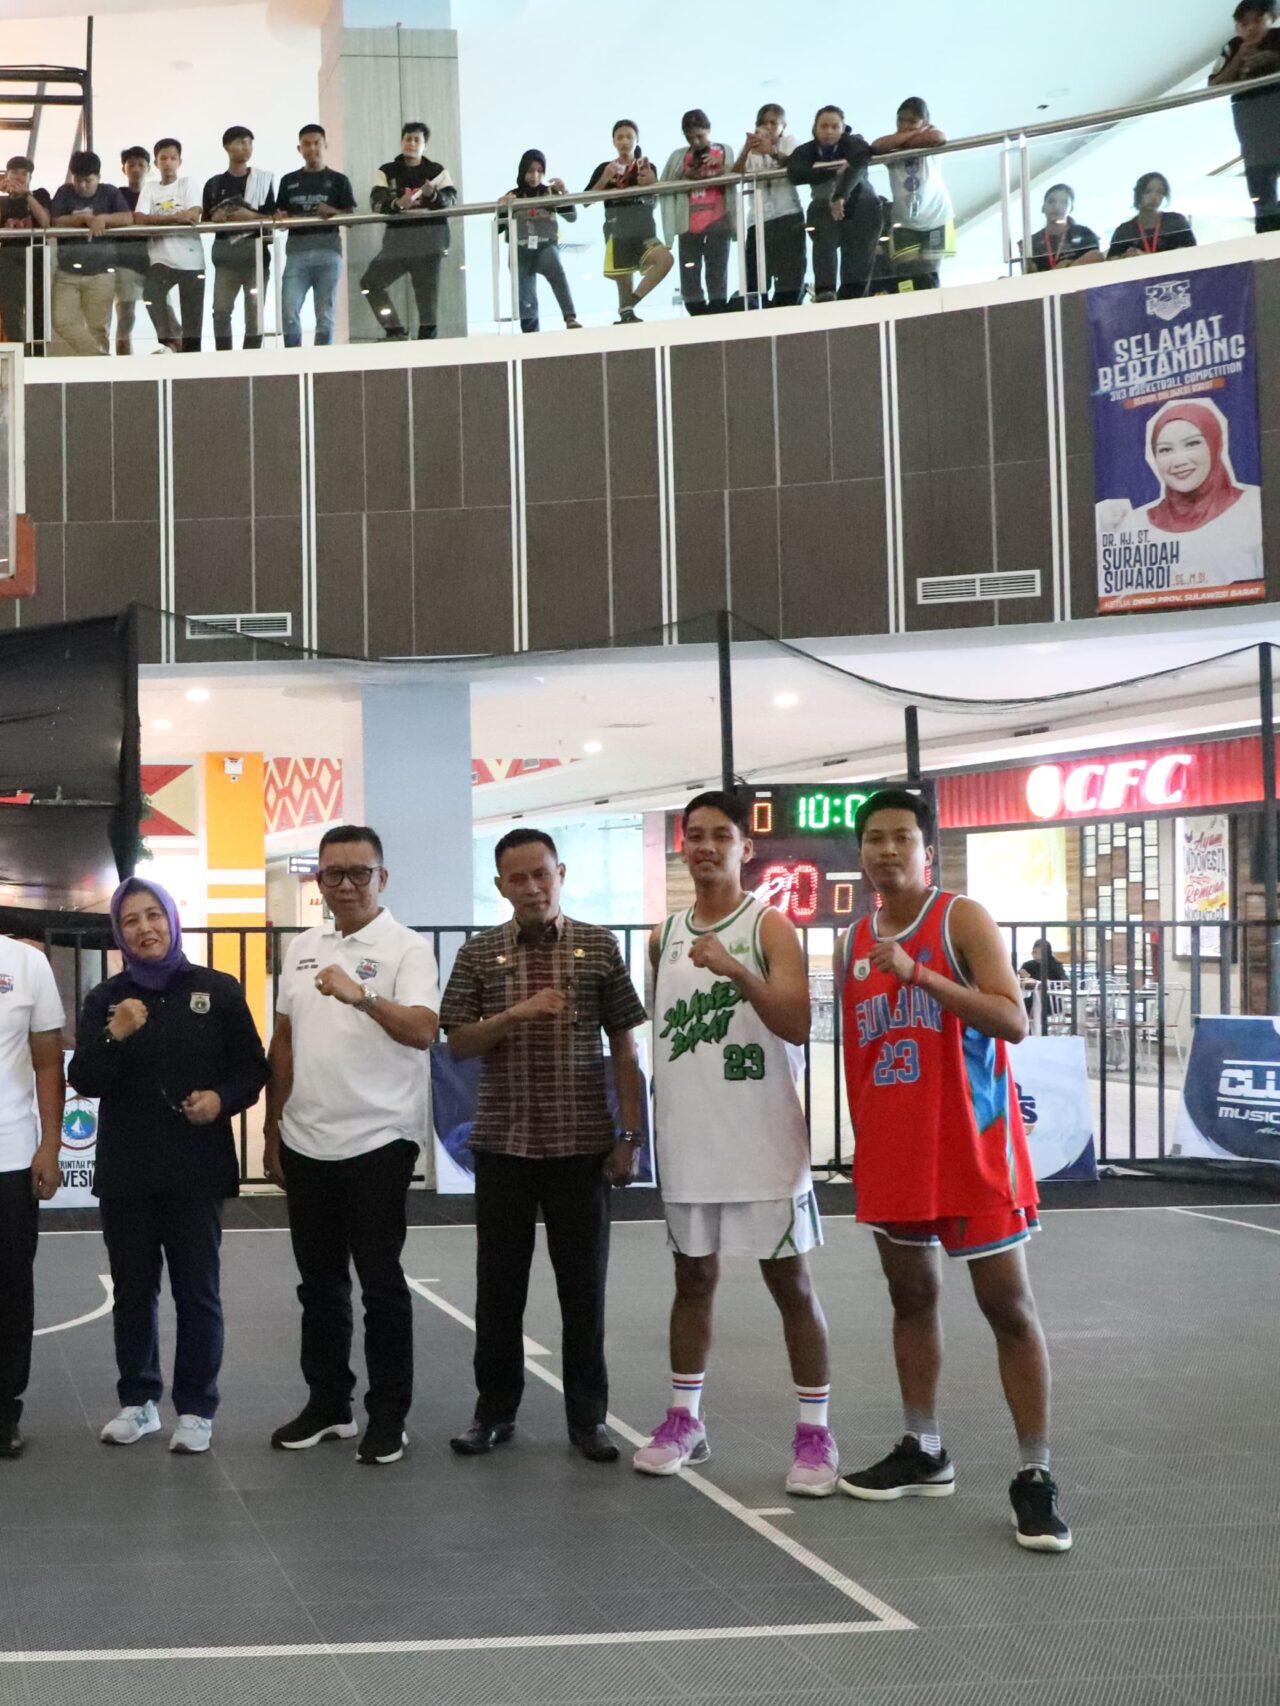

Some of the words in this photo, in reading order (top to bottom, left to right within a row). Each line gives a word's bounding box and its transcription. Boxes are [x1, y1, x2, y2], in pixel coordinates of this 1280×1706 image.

[1114, 315, 1224, 362] SELAMAT
[1098, 334, 1246, 390] BERTANDING
[1129, 376, 1183, 398] BASKETBALL
[1184, 361, 1243, 385] COMPETITION
[1102, 533, 1117, 547] DR.
[1120, 531, 1134, 545] HJ.
[1138, 530, 1151, 543] ST.
[1102, 541, 1180, 571] SURAIDAH
[1104, 566, 1171, 594] SUHARDI
[1132, 597, 1156, 606] DPRD
[1157, 594, 1183, 604] PROV.
[1184, 590, 1229, 601] SULAWESI
[1230, 587, 1261, 597] BARAT
[1063, 754, 1192, 812] CFC
[668, 1009, 735, 1062] BARAT
[723, 1043, 765, 1080] 23
[873, 1038, 920, 1086] 23
